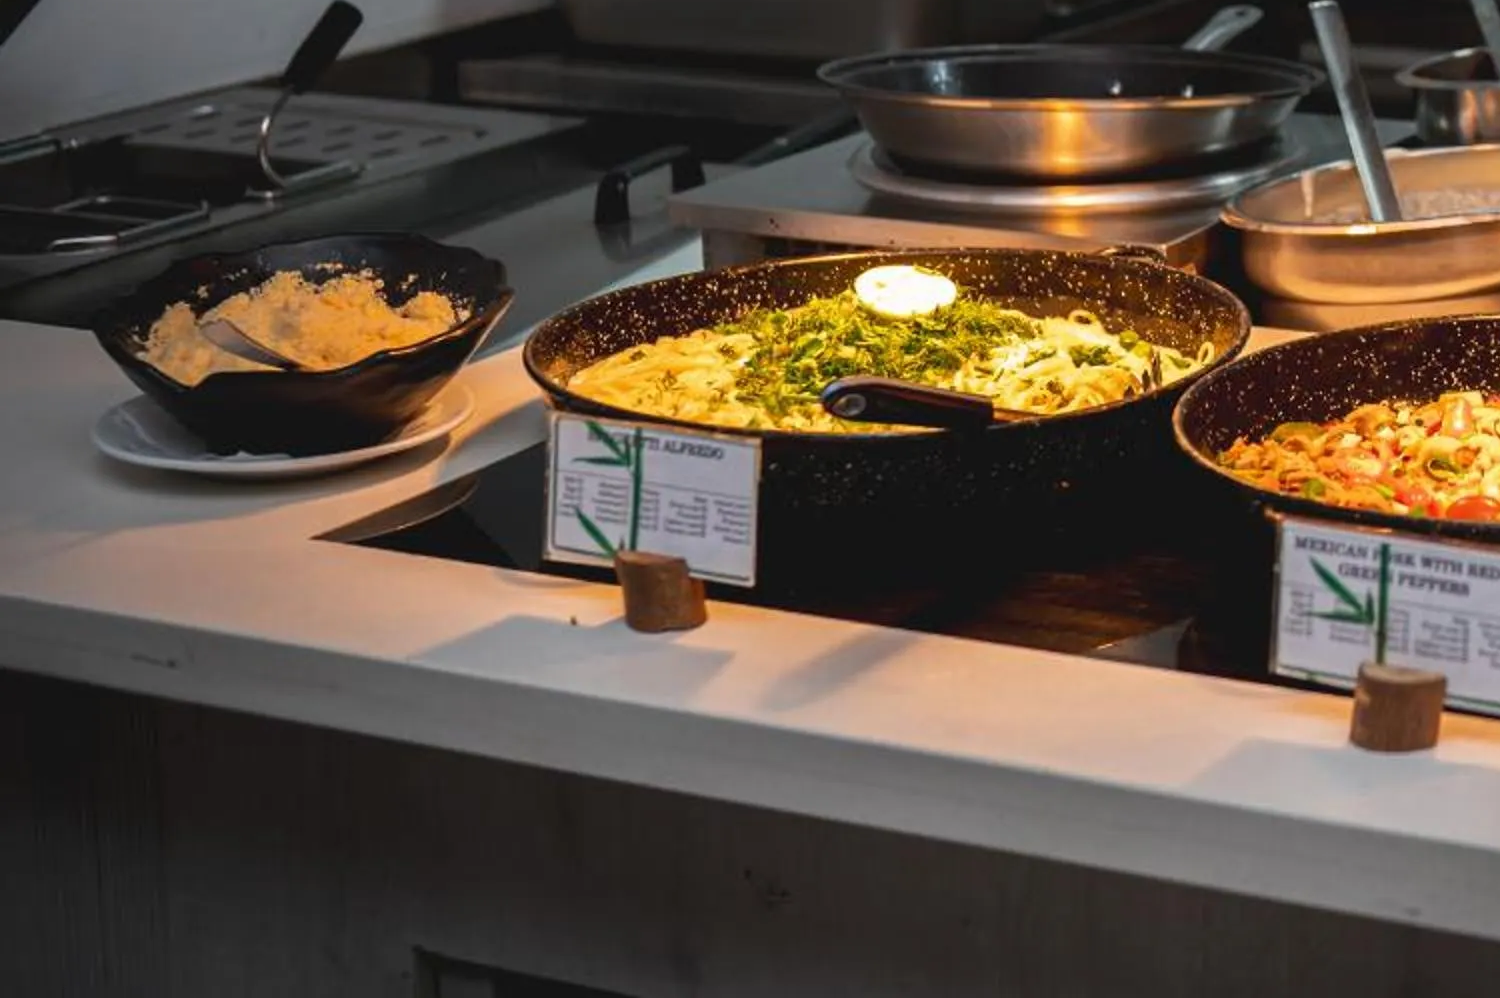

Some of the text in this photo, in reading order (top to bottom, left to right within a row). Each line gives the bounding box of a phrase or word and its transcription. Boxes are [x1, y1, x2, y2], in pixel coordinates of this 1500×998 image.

[663, 440, 724, 461] ALFREDO
[1295, 535, 1367, 559] MEXICAN
[1372, 547, 1415, 567] PRK
[1420, 554, 1463, 575] WITH
[1398, 573, 1470, 597] PEPPERS
